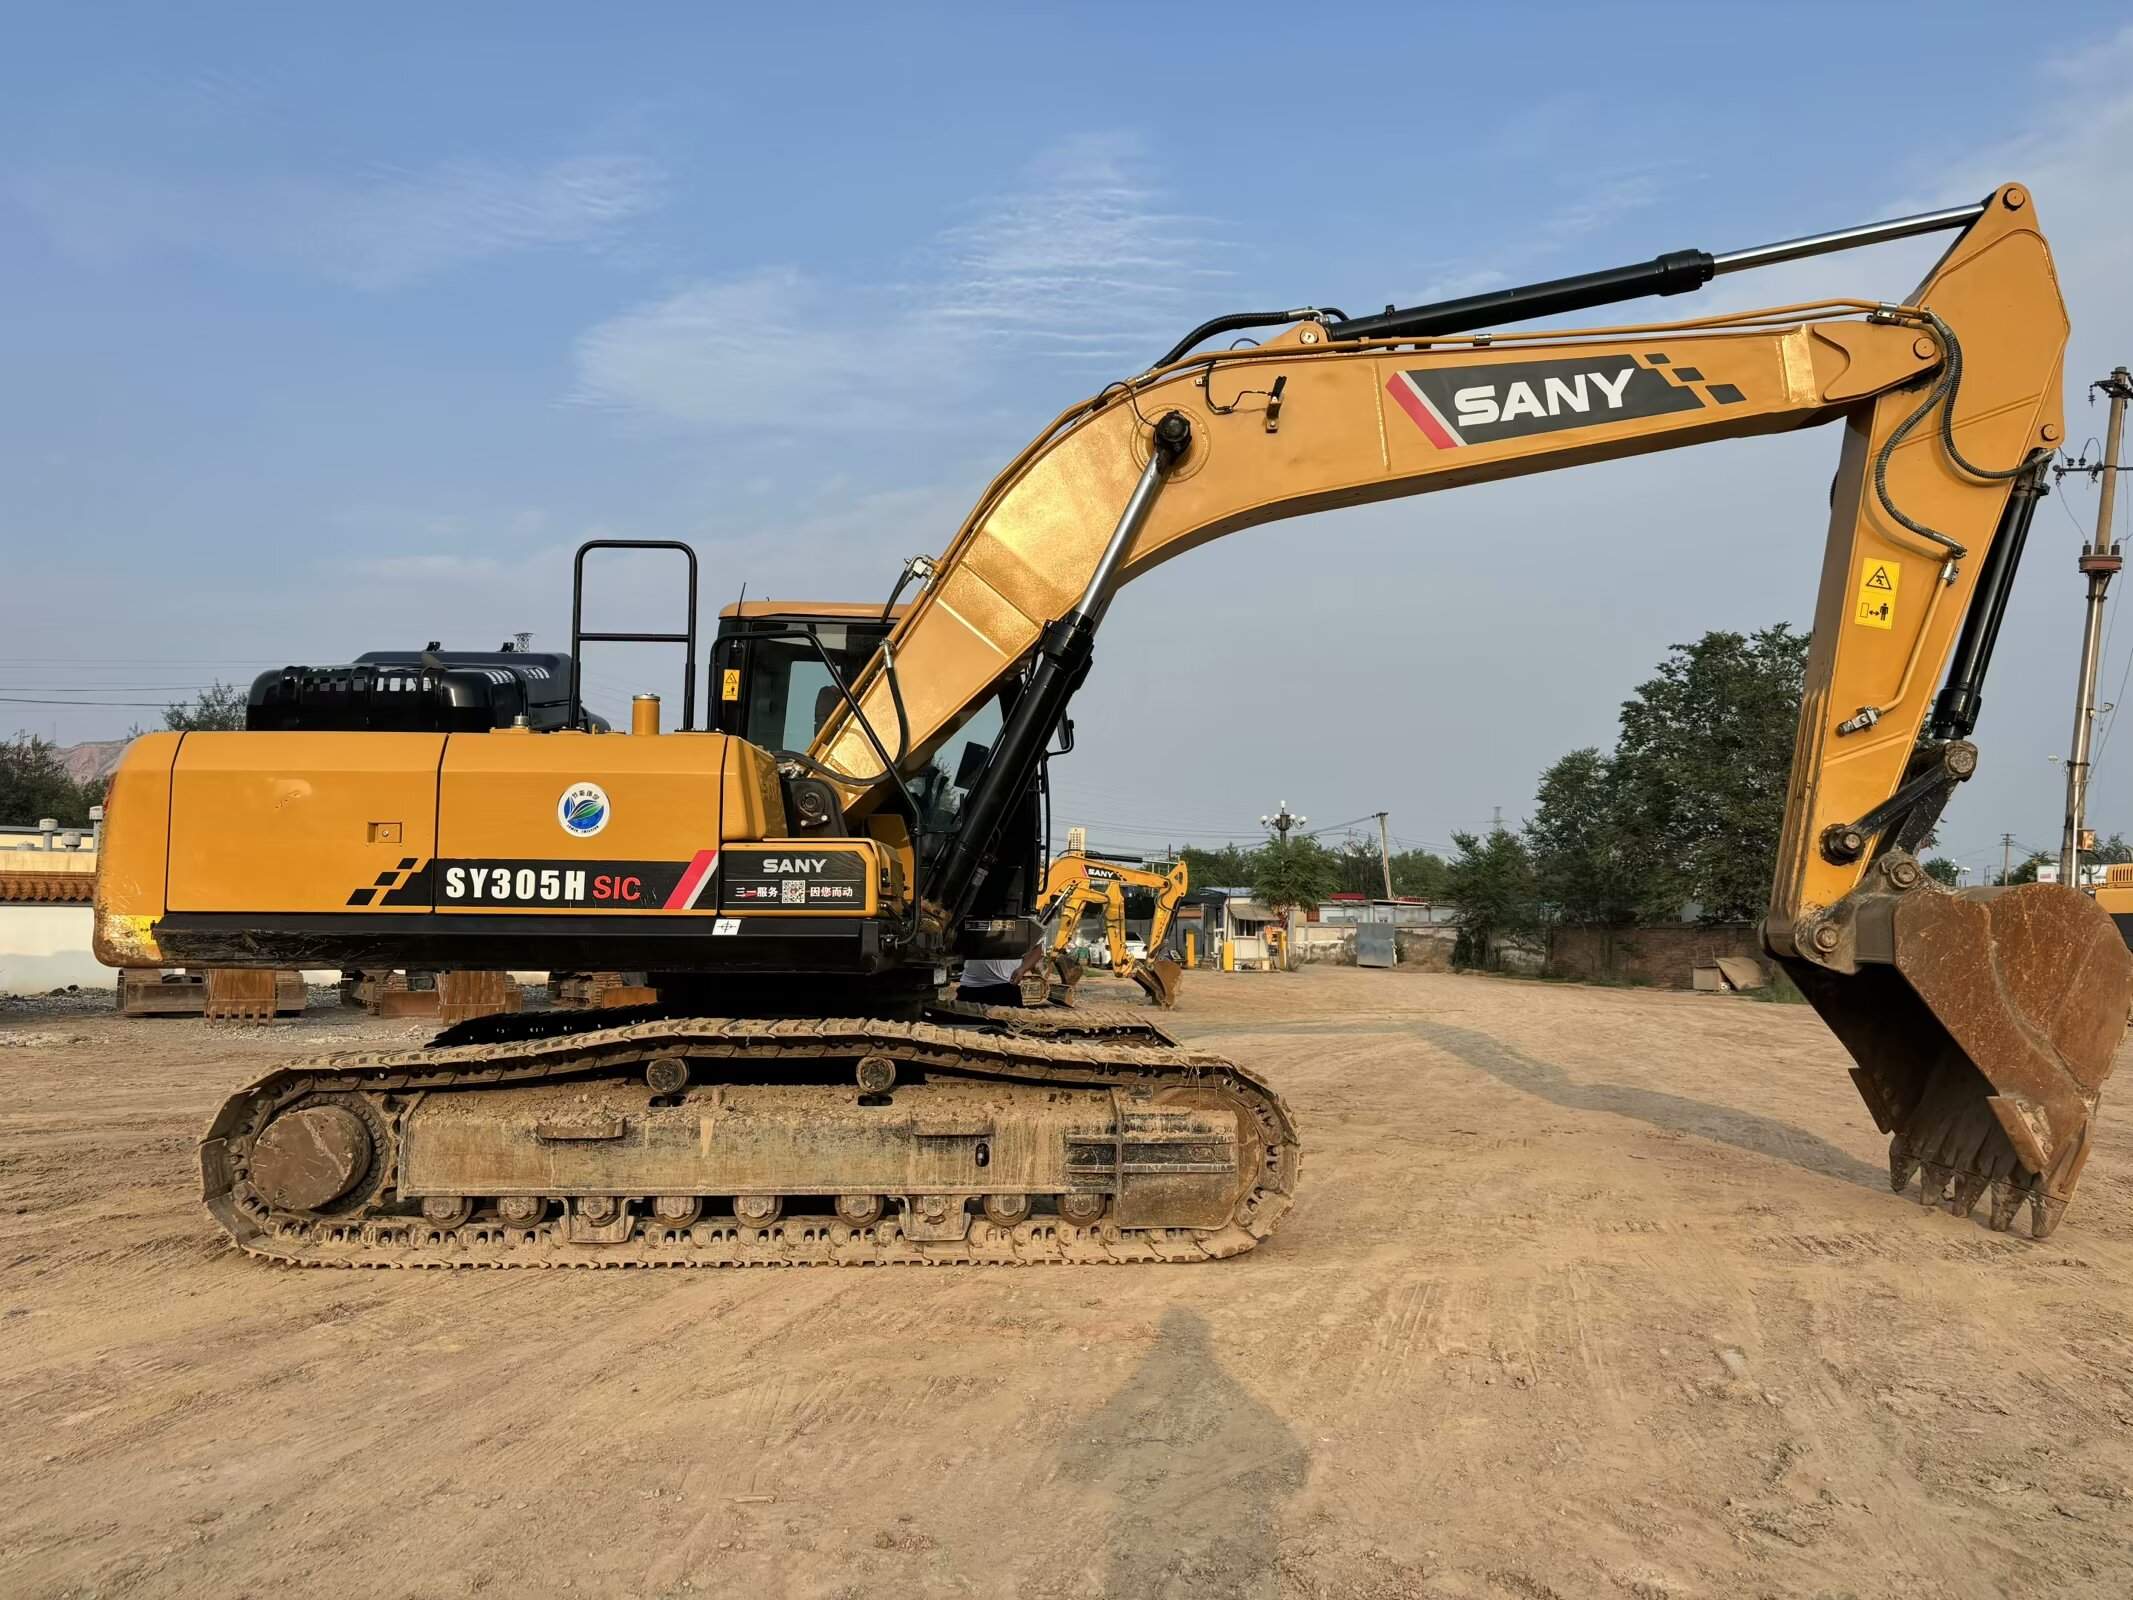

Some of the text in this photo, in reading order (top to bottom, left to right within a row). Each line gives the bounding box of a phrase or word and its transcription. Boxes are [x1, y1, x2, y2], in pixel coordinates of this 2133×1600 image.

[1454, 367, 1636, 427] SANY
[762, 858, 827, 873] SANY
[1088, 868, 1113, 878] SANY
[446, 867, 641, 901] SY305H SIC
[735, 886, 854, 898] 三一服务 因您而动
